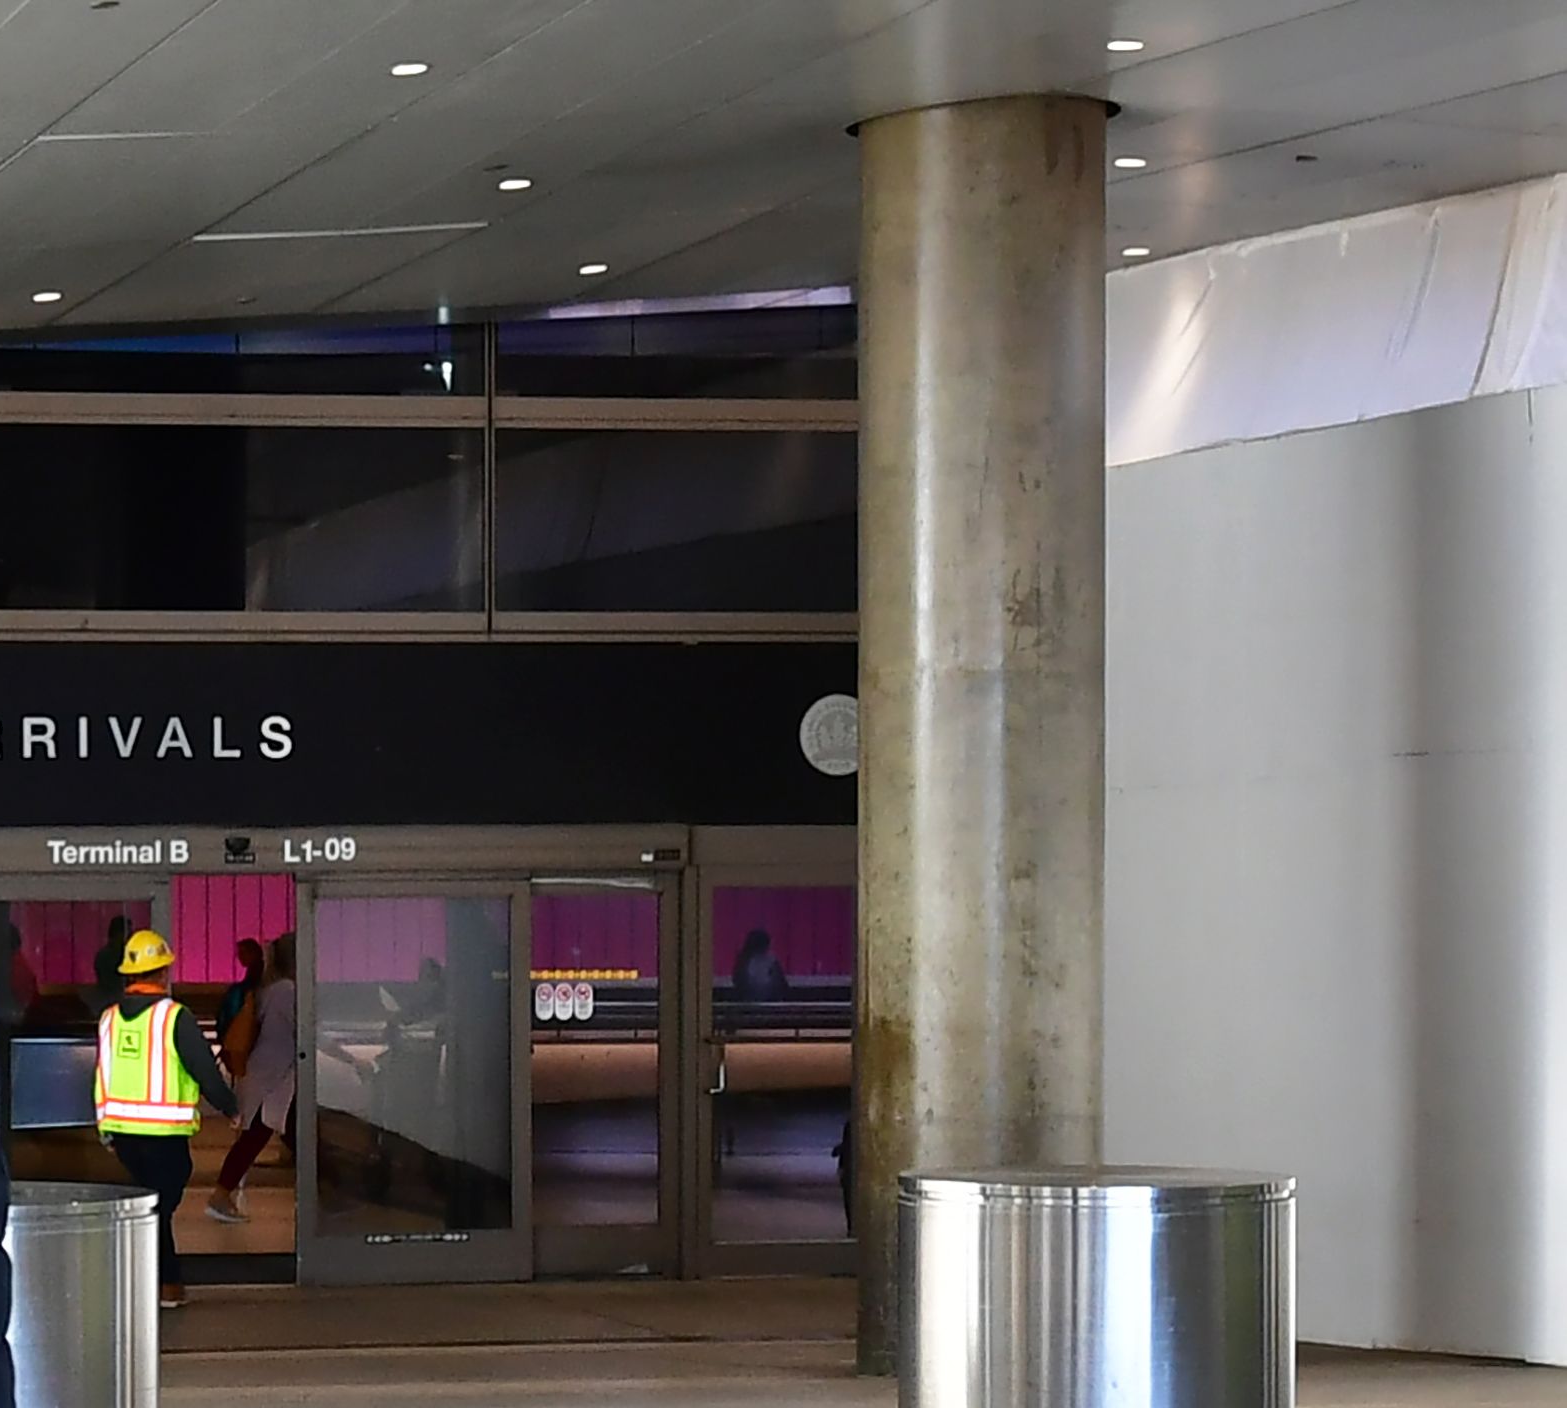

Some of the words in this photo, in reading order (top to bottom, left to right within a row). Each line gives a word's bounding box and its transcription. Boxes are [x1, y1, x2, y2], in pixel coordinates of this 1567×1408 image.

[47, 840, 161, 864] Terminal
[170, 840, 189, 863] B
[284, 838, 356, 862] L1-09
